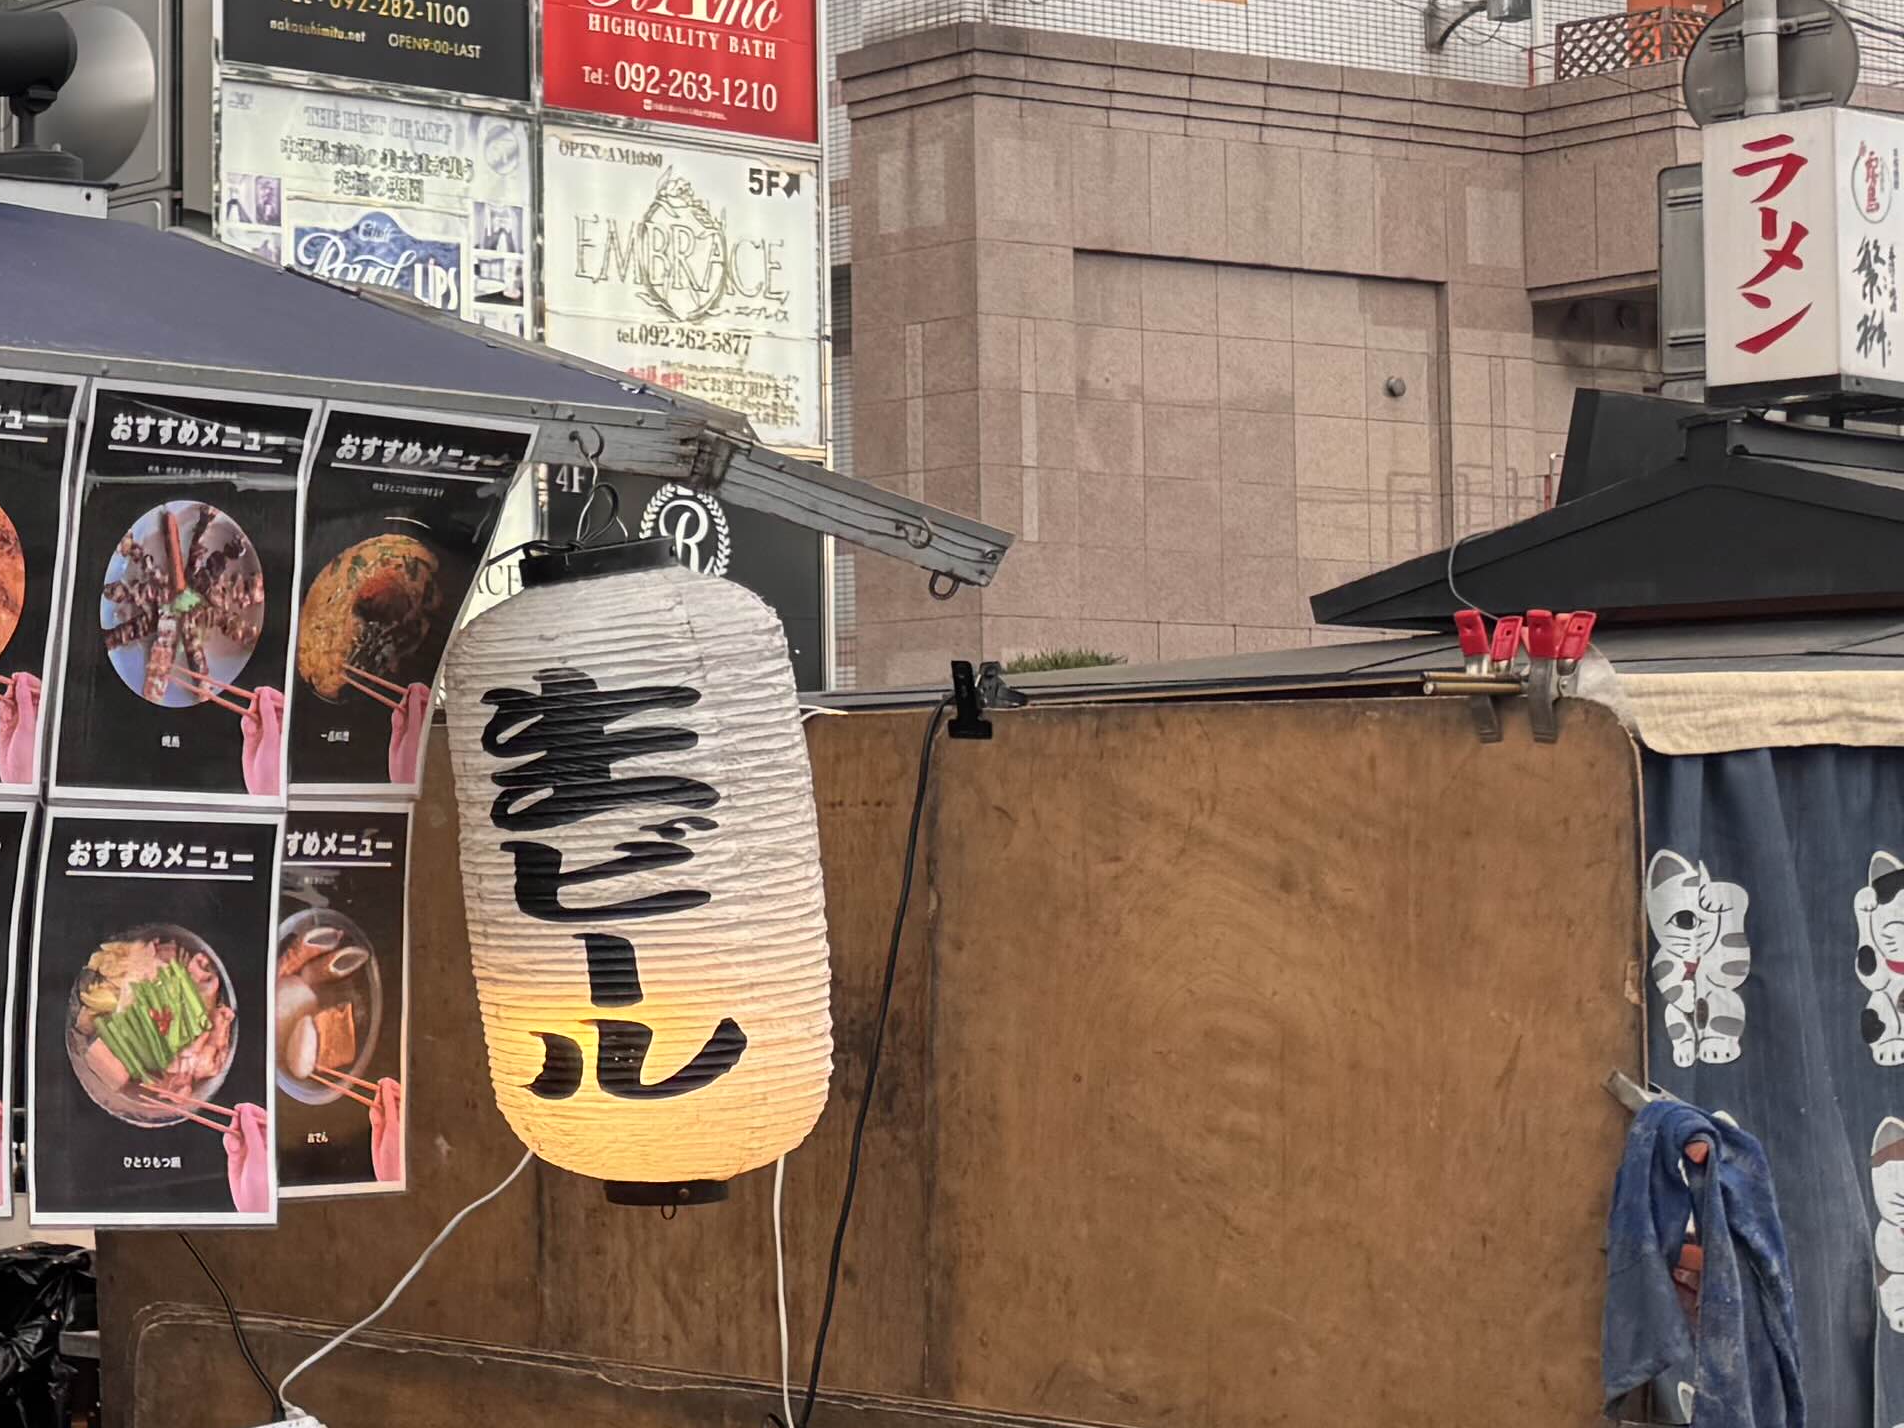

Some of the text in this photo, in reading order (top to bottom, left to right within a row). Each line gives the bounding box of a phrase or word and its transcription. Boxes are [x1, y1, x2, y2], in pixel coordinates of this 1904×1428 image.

[588, 13, 776, 60] HIGHQUALITY BATH
[615, 60, 777, 112] 092-263-1210
[748, 168, 781, 197] 5F
[574, 213, 790, 304] EMBRACE
[1732, 133, 1814, 355] ラーメン
[111, 413, 286, 451] おすすめメニュー
[336, 433, 503, 471] おすすめメニュー
[67, 839, 254, 869] おすすめメニュー
[480, 667, 749, 1101] 生ビール
